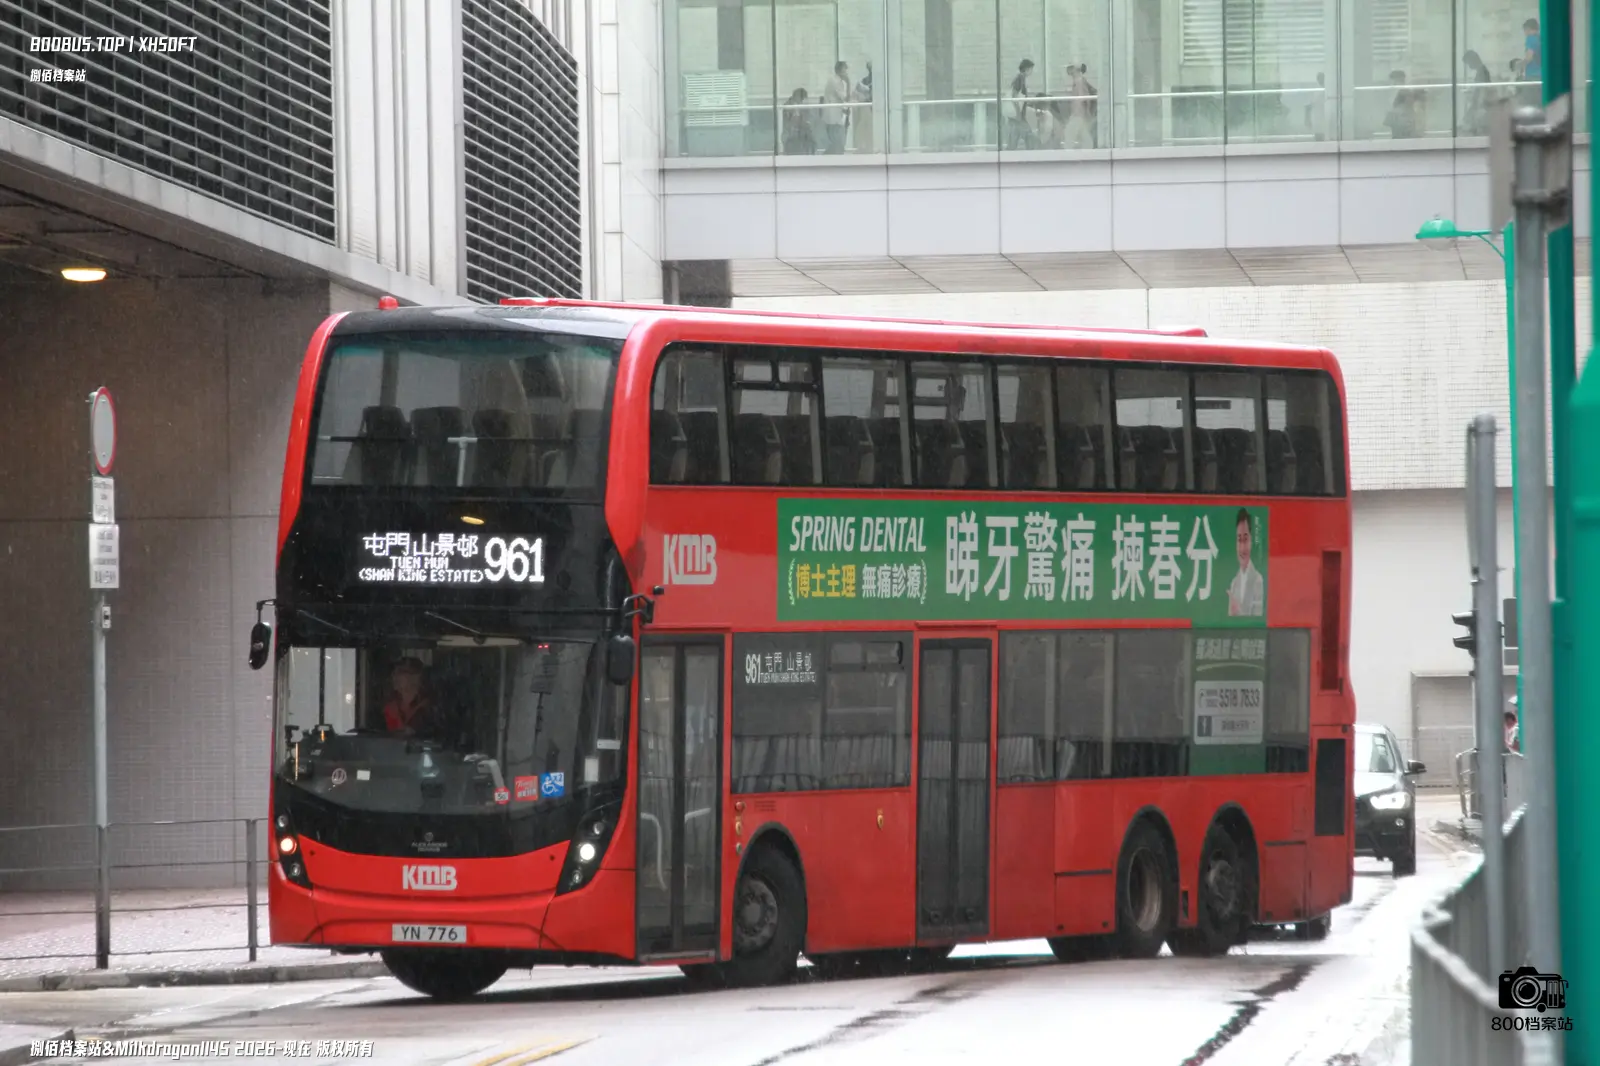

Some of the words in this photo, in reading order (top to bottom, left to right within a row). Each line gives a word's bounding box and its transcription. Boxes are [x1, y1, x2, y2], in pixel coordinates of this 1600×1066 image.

[363, 532, 479, 558] 屯門山景邨
[789, 516, 856, 551] SPRING
[860, 517, 927, 552] DENTAL
[390, 556, 421, 569] TUEN
[424, 557, 450, 569] MUN
[484, 537, 545, 582] 961
[663, 534, 717, 585] KMB
[945, 510, 1097, 602] 睇牙驚痛
[1111, 513, 1219, 603] 揀春分
[398, 569, 427, 582] KING
[796, 563, 857, 599] 博士主理
[862, 563, 922, 599] 無痛診療
[745, 653, 761, 684] 961
[402, 864, 457, 891] KMB
[401, 926, 420, 940] YN
[428, 926, 458, 941] 776
